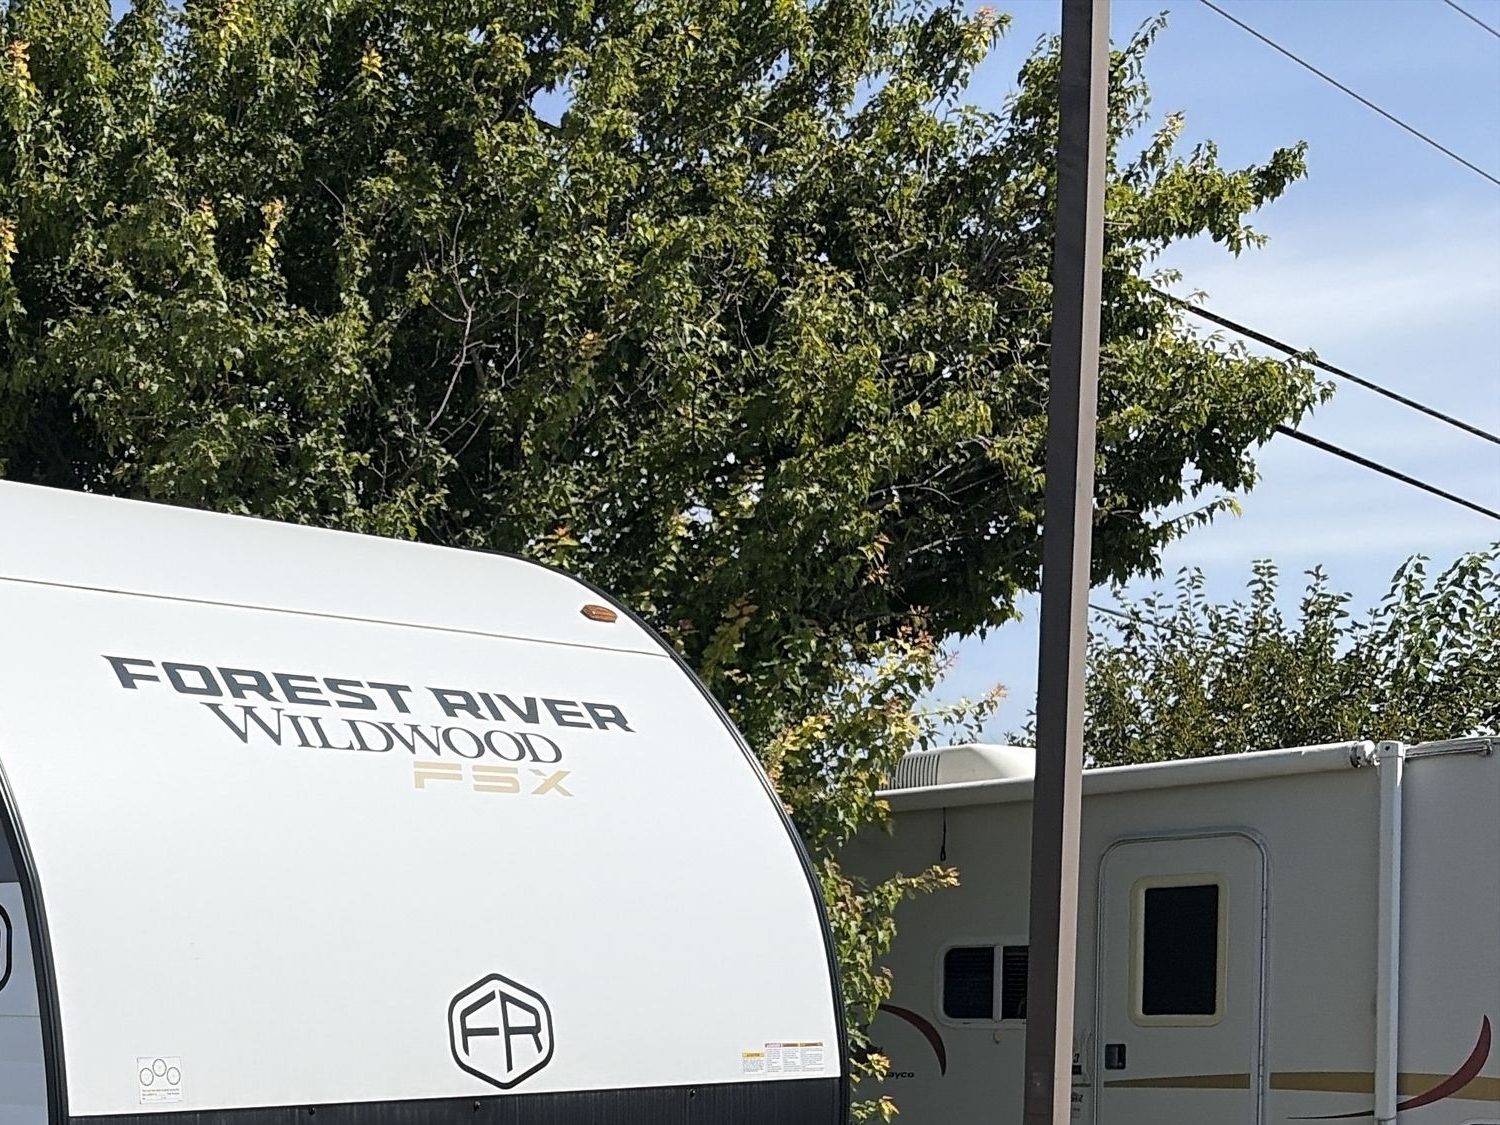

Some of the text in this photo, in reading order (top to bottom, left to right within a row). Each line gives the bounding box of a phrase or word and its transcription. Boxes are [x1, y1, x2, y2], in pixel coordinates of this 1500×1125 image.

[100, 655, 636, 733] FOREST RIVER
[199, 702, 563, 763] WILDWOOD
[413, 760, 574, 798] FSX
[460, 988, 543, 1074] FR
